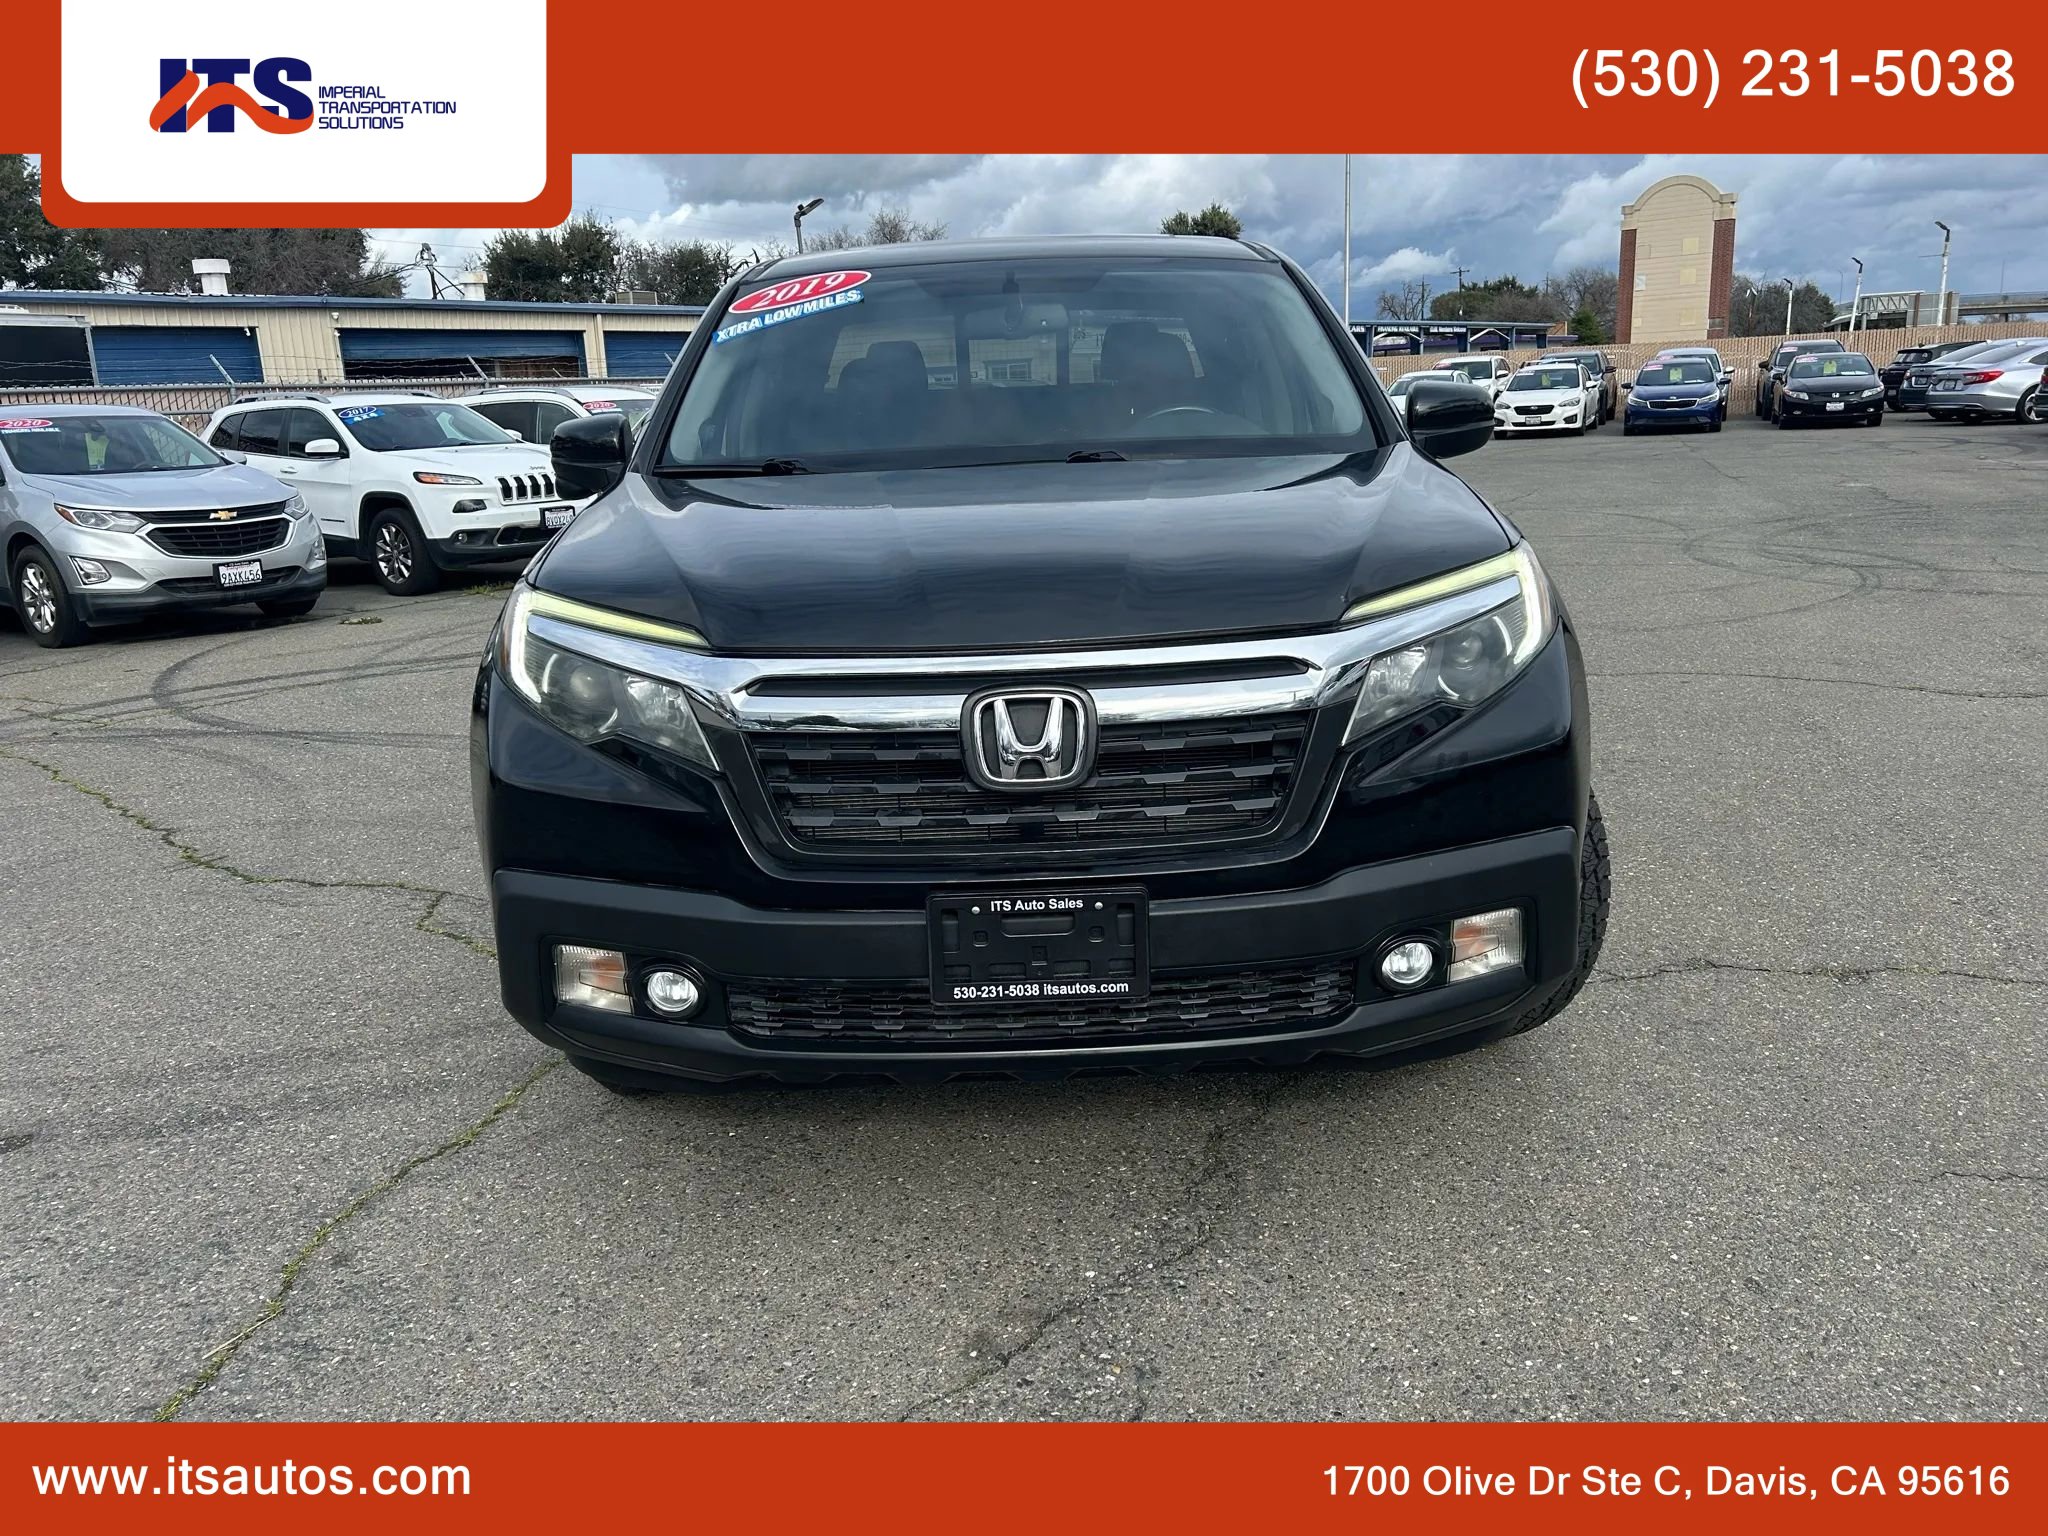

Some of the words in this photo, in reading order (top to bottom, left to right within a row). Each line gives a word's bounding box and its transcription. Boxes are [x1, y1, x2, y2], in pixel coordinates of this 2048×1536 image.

[752, 272, 847, 308] 2019
[716, 315, 763, 343] XTRA
[802, 289, 863, 315] MILES
[346, 406, 370, 417] 2017
[6, 419, 42, 428] 2020
[221, 568, 261, 584] 9AXK456
[990, 900, 1012, 912] ITS
[1014, 899, 1046, 911] Auto
[1048, 897, 1084, 910] Sales
[953, 983, 1040, 1000] 530-231-5038
[1043, 982, 1129, 997] itsautos.com
